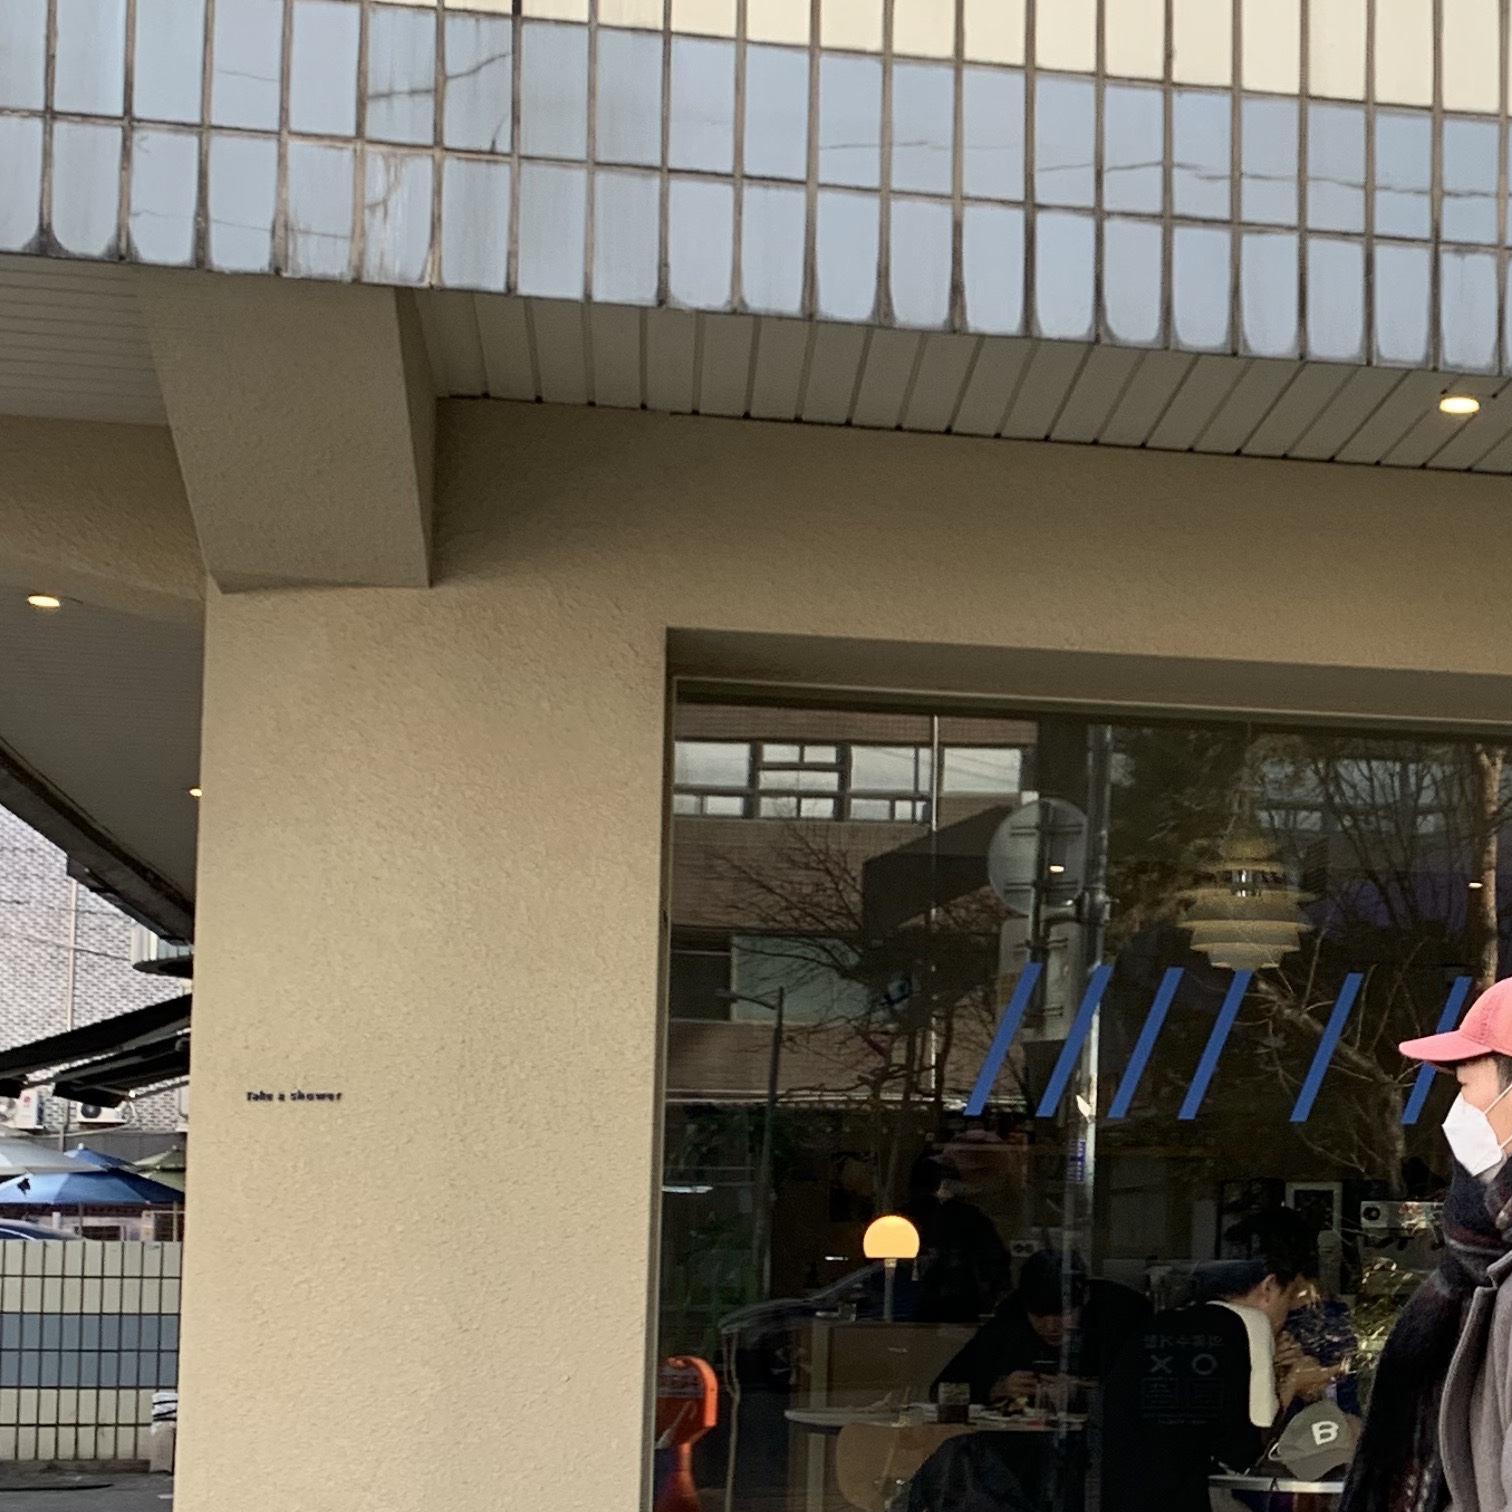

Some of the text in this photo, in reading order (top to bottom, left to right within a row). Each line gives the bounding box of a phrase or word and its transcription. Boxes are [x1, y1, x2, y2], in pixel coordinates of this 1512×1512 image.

[278, 1093, 286, 1101] a
[290, 1090, 342, 1101] shower
[1311, 1421, 1339, 1445] B
